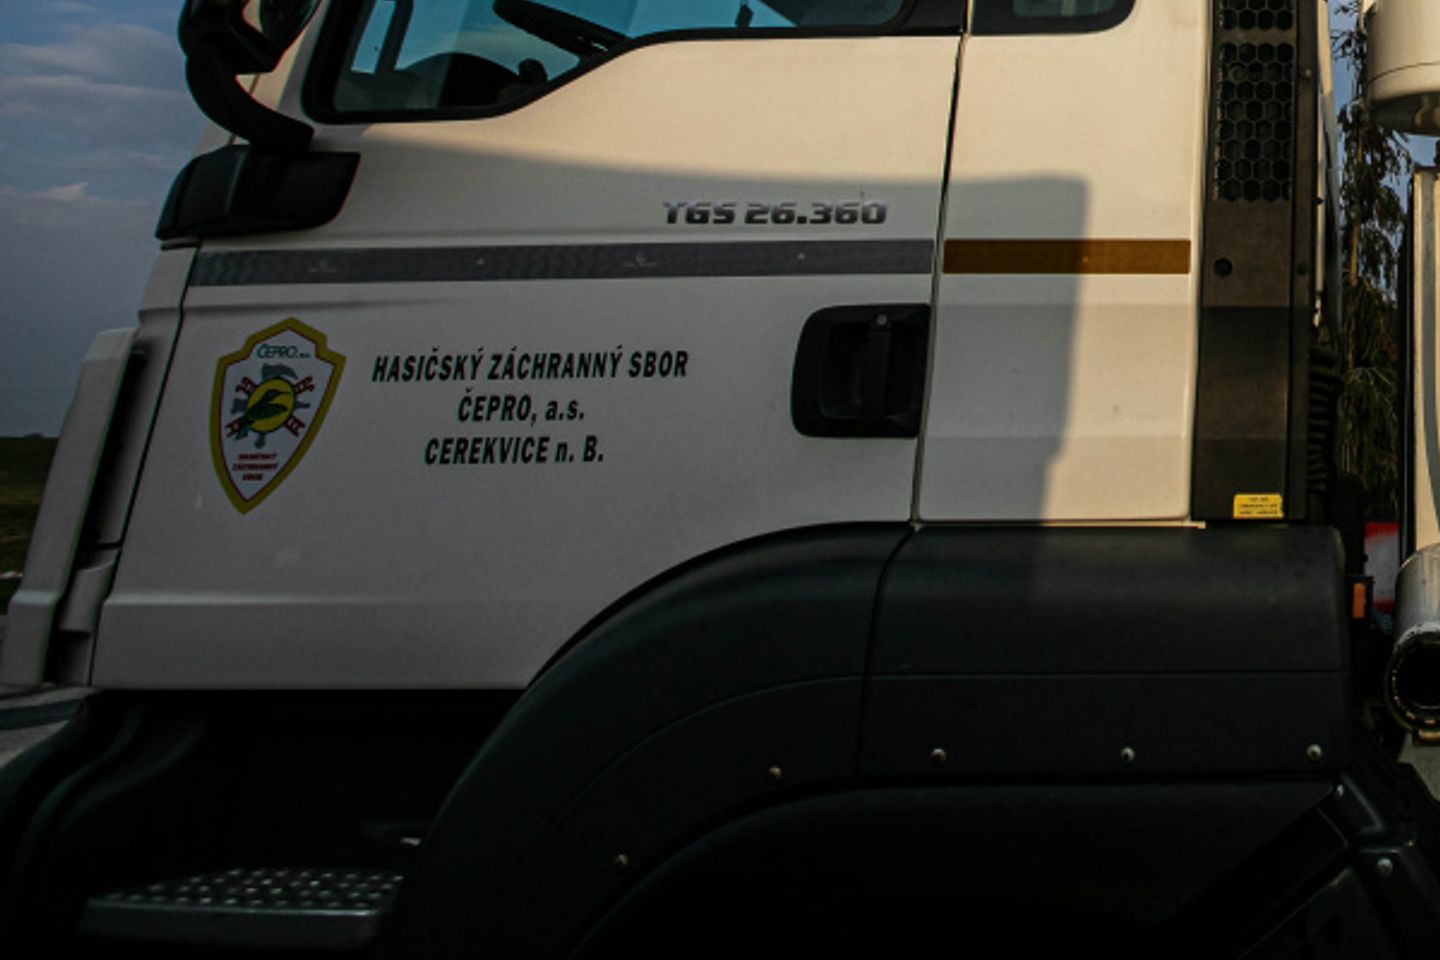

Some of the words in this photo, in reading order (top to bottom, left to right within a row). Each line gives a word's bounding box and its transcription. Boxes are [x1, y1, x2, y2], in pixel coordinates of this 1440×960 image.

[663, 202, 736, 225] TGS
[745, 201, 889, 225] 26.360
[372, 347, 484, 382] HASIČSKÝ
[487, 344, 623, 380] ZÁCHRANNÝ
[628, 350, 688, 378] SBOR
[457, 387, 537, 427] ČEPRO,
[545, 400, 584, 421] a.s.
[425, 436, 550, 465] CEREKVICE
[555, 441, 575, 462] n.
[583, 435, 604, 462] B.
